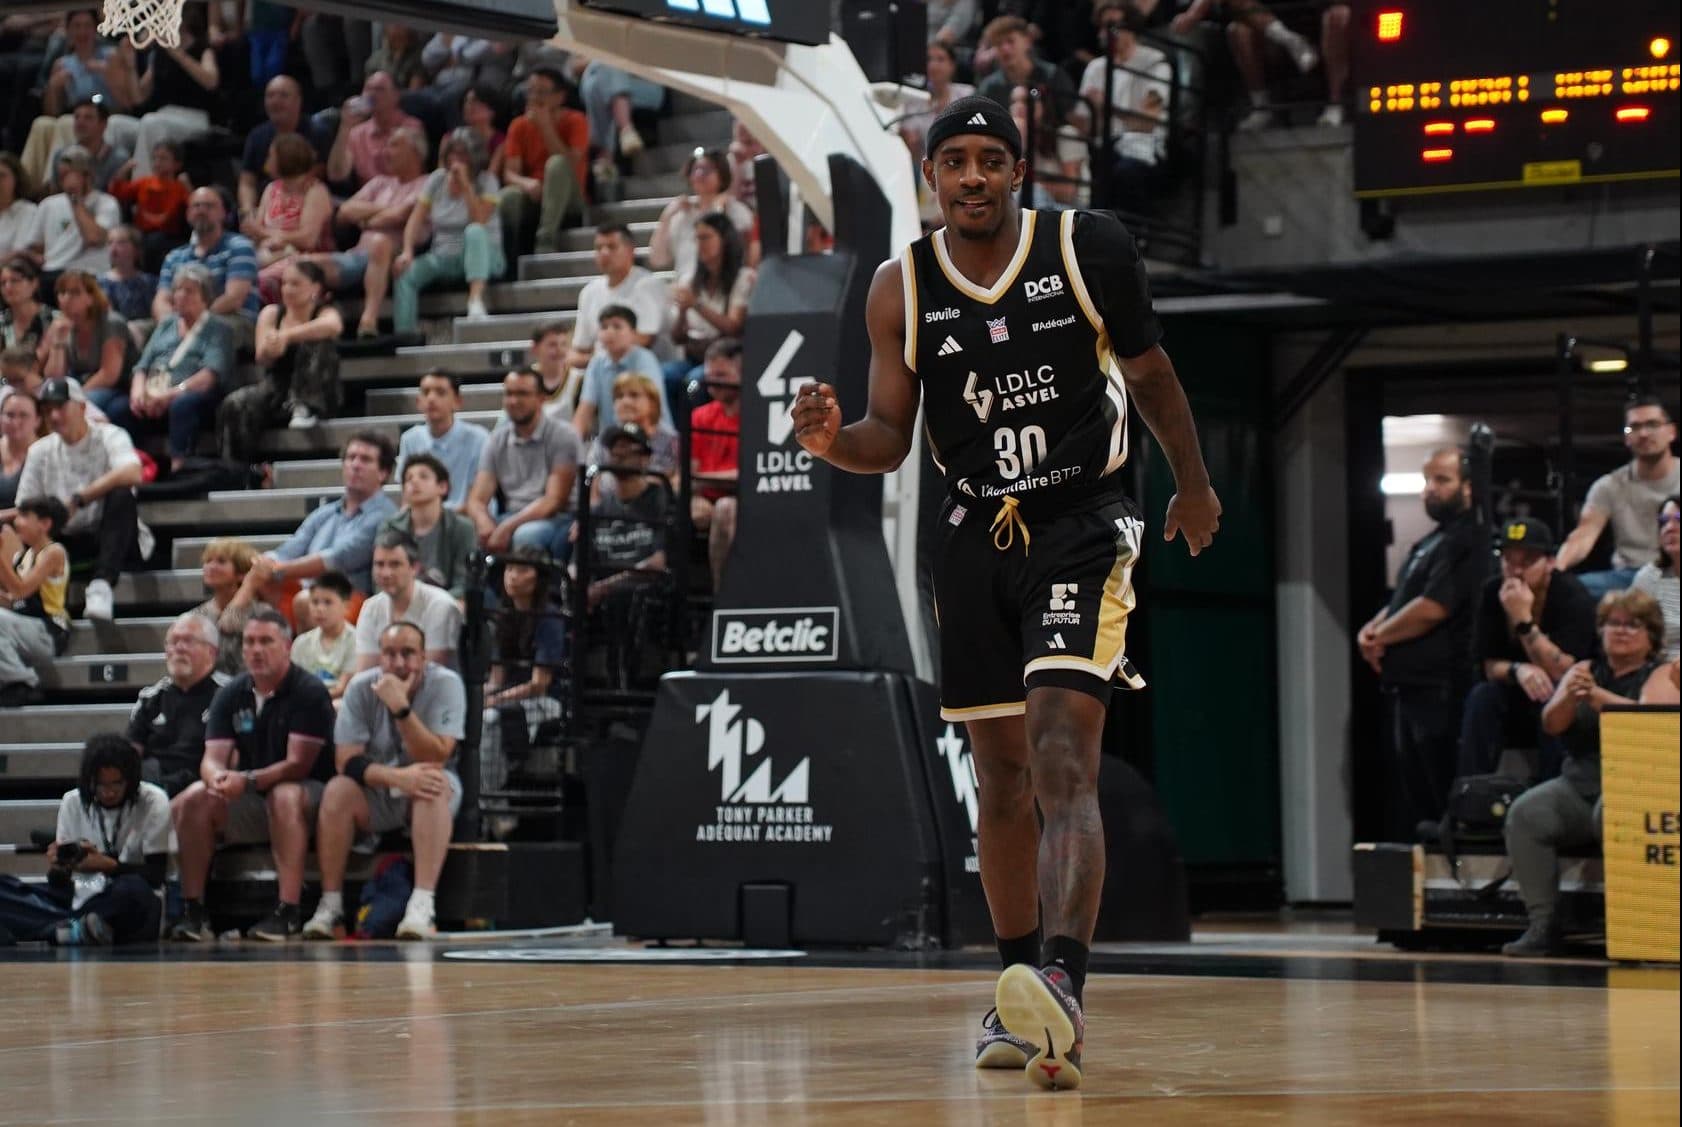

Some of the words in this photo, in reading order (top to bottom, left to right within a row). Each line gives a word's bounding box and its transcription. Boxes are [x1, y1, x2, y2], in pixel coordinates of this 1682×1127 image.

[1024, 275, 1063, 298] DCB
[925, 307, 961, 323] swile
[995, 365, 1055, 395] LDLC
[1002, 386, 1060, 411] ASVEL
[756, 451, 813, 474] LDLC
[993, 424, 1048, 480] 30
[756, 474, 812, 493] ASVEL
[1050, 466, 1082, 485] BTP
[721, 617, 829, 653] Betclic
[716, 806, 753, 823] TONY
[757, 806, 814, 823] PARKER
[765, 824, 833, 842] ACADEMY
